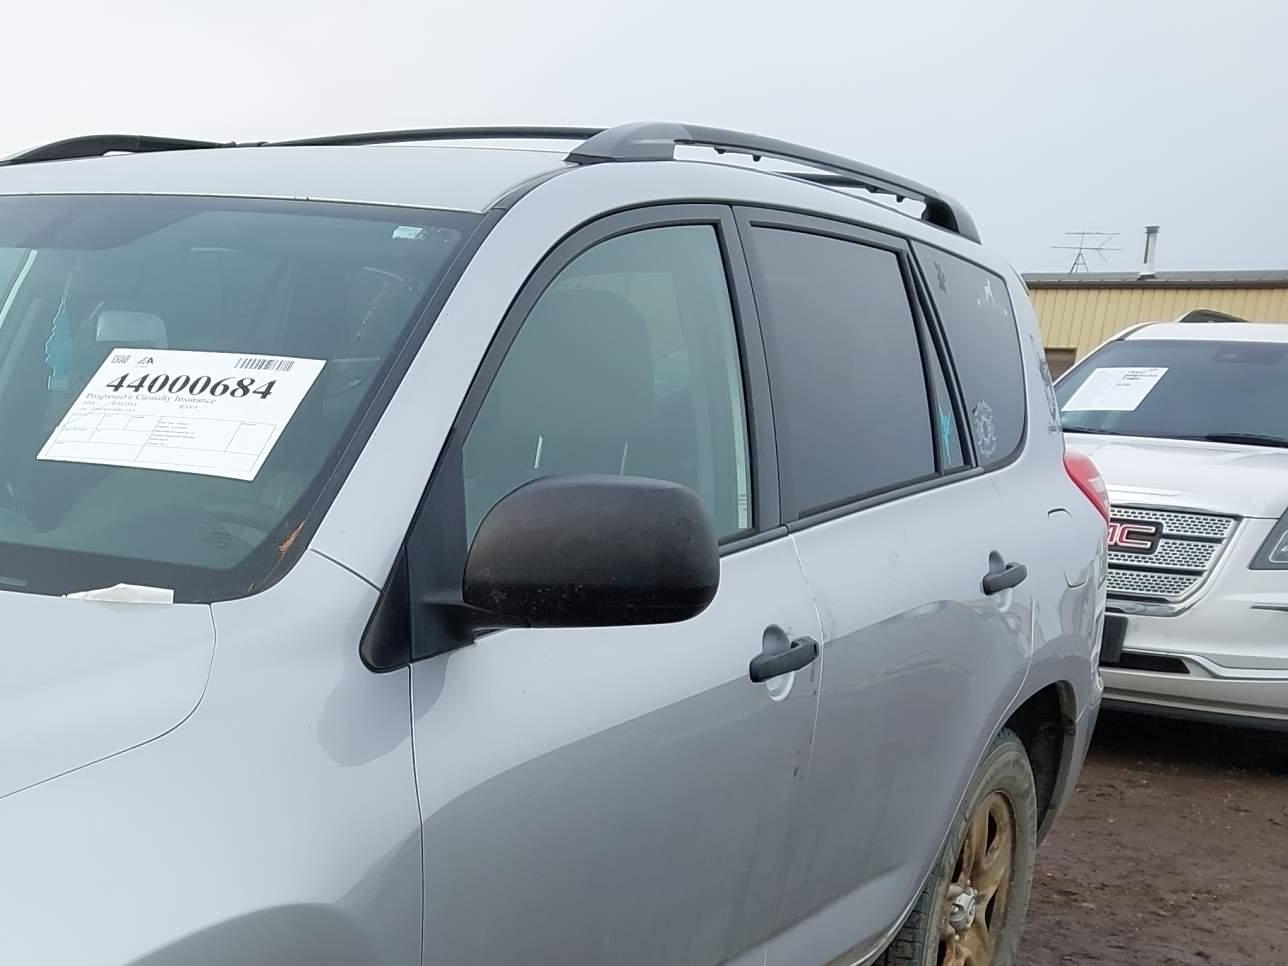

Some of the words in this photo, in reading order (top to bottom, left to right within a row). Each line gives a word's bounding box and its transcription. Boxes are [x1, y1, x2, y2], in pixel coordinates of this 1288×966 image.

[106, 373, 276, 399] 44000684
[136, 393, 171, 403] Casualty
[174, 395, 217, 405] Insurance
